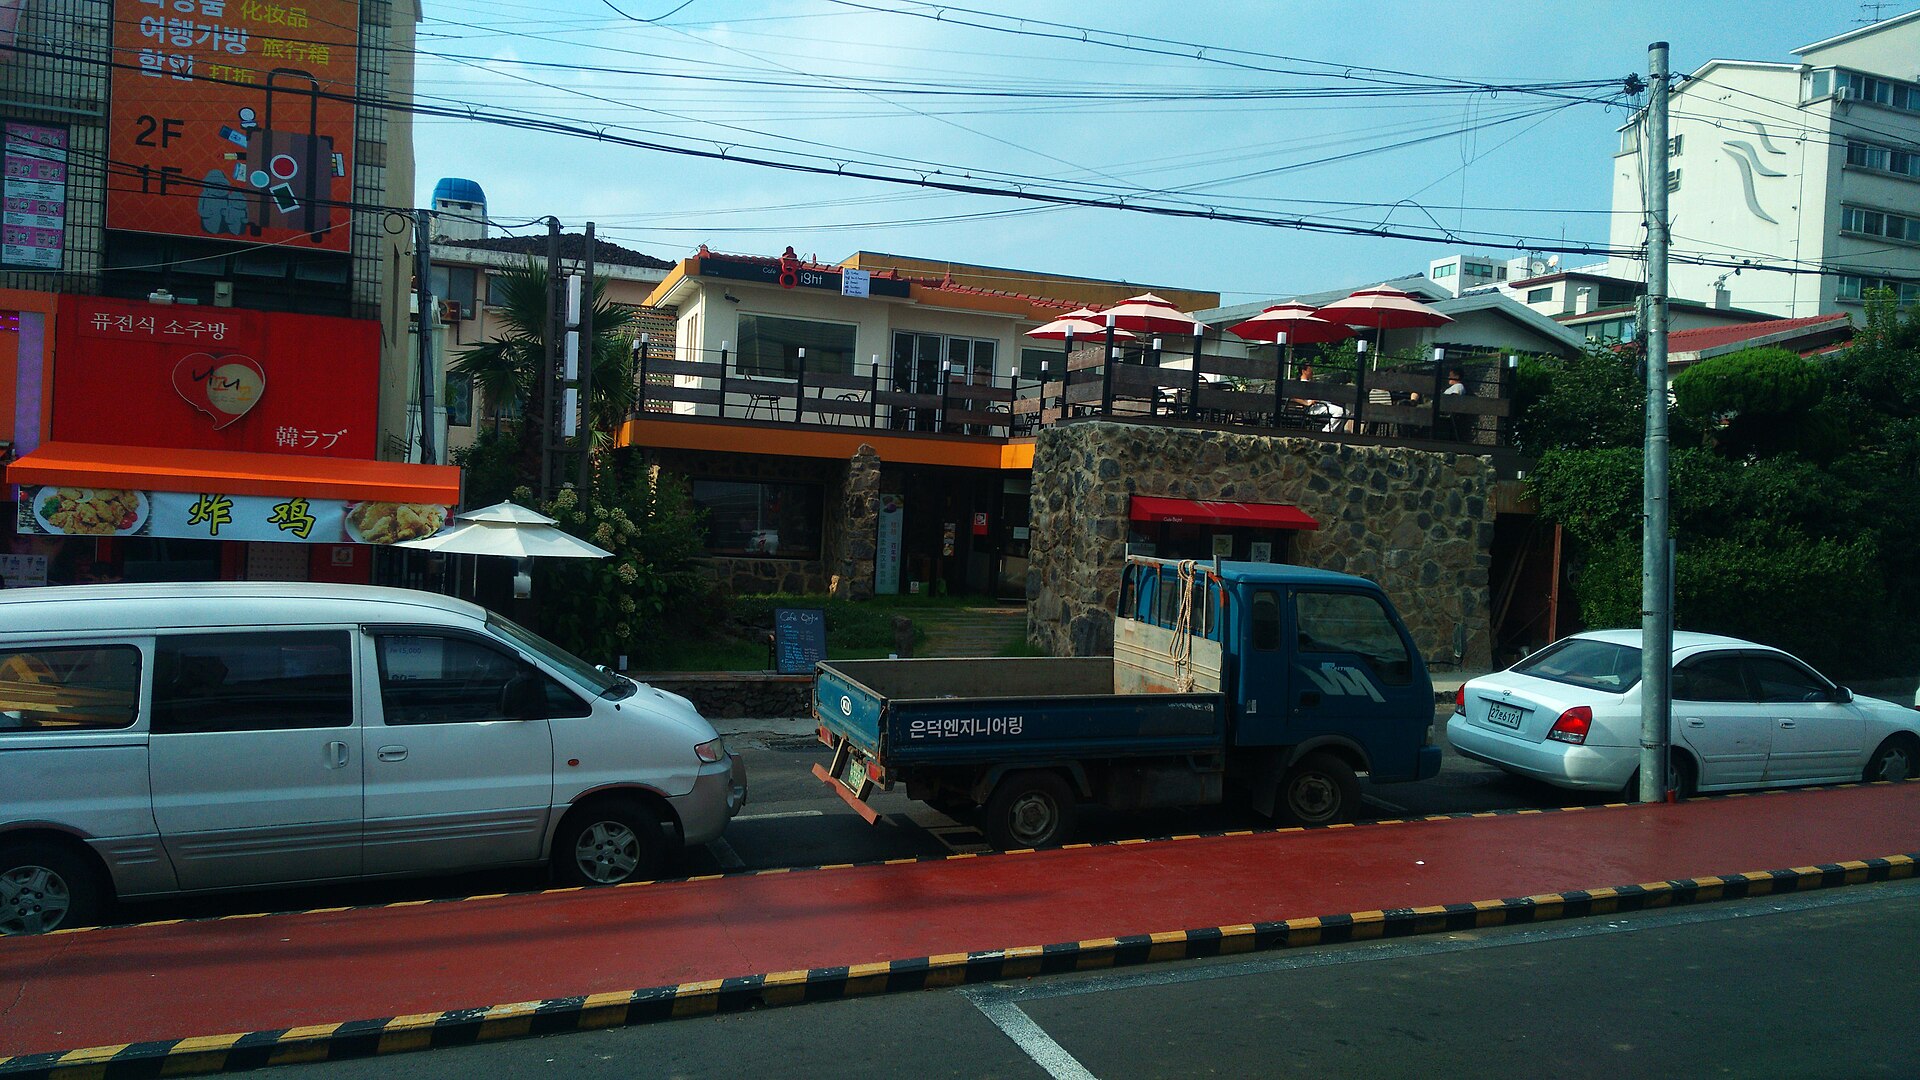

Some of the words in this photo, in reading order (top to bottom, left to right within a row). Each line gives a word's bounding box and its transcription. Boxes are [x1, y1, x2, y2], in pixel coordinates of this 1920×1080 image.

[240, 1, 309, 28] 化妆品
[139, 16, 250, 55] 여행가방
[138, 48, 194, 82] 할인
[261, 38, 331, 66] 旅行箱
[135, 114, 184, 149] 2F
[137, 164, 182, 196] 1F
[90, 312, 155, 335] 퓨전식
[163, 319, 229, 340] 소주방
[275, 425, 348, 450] 韓ラブ
[909, 716, 1023, 739] 은덕엔지니어링
